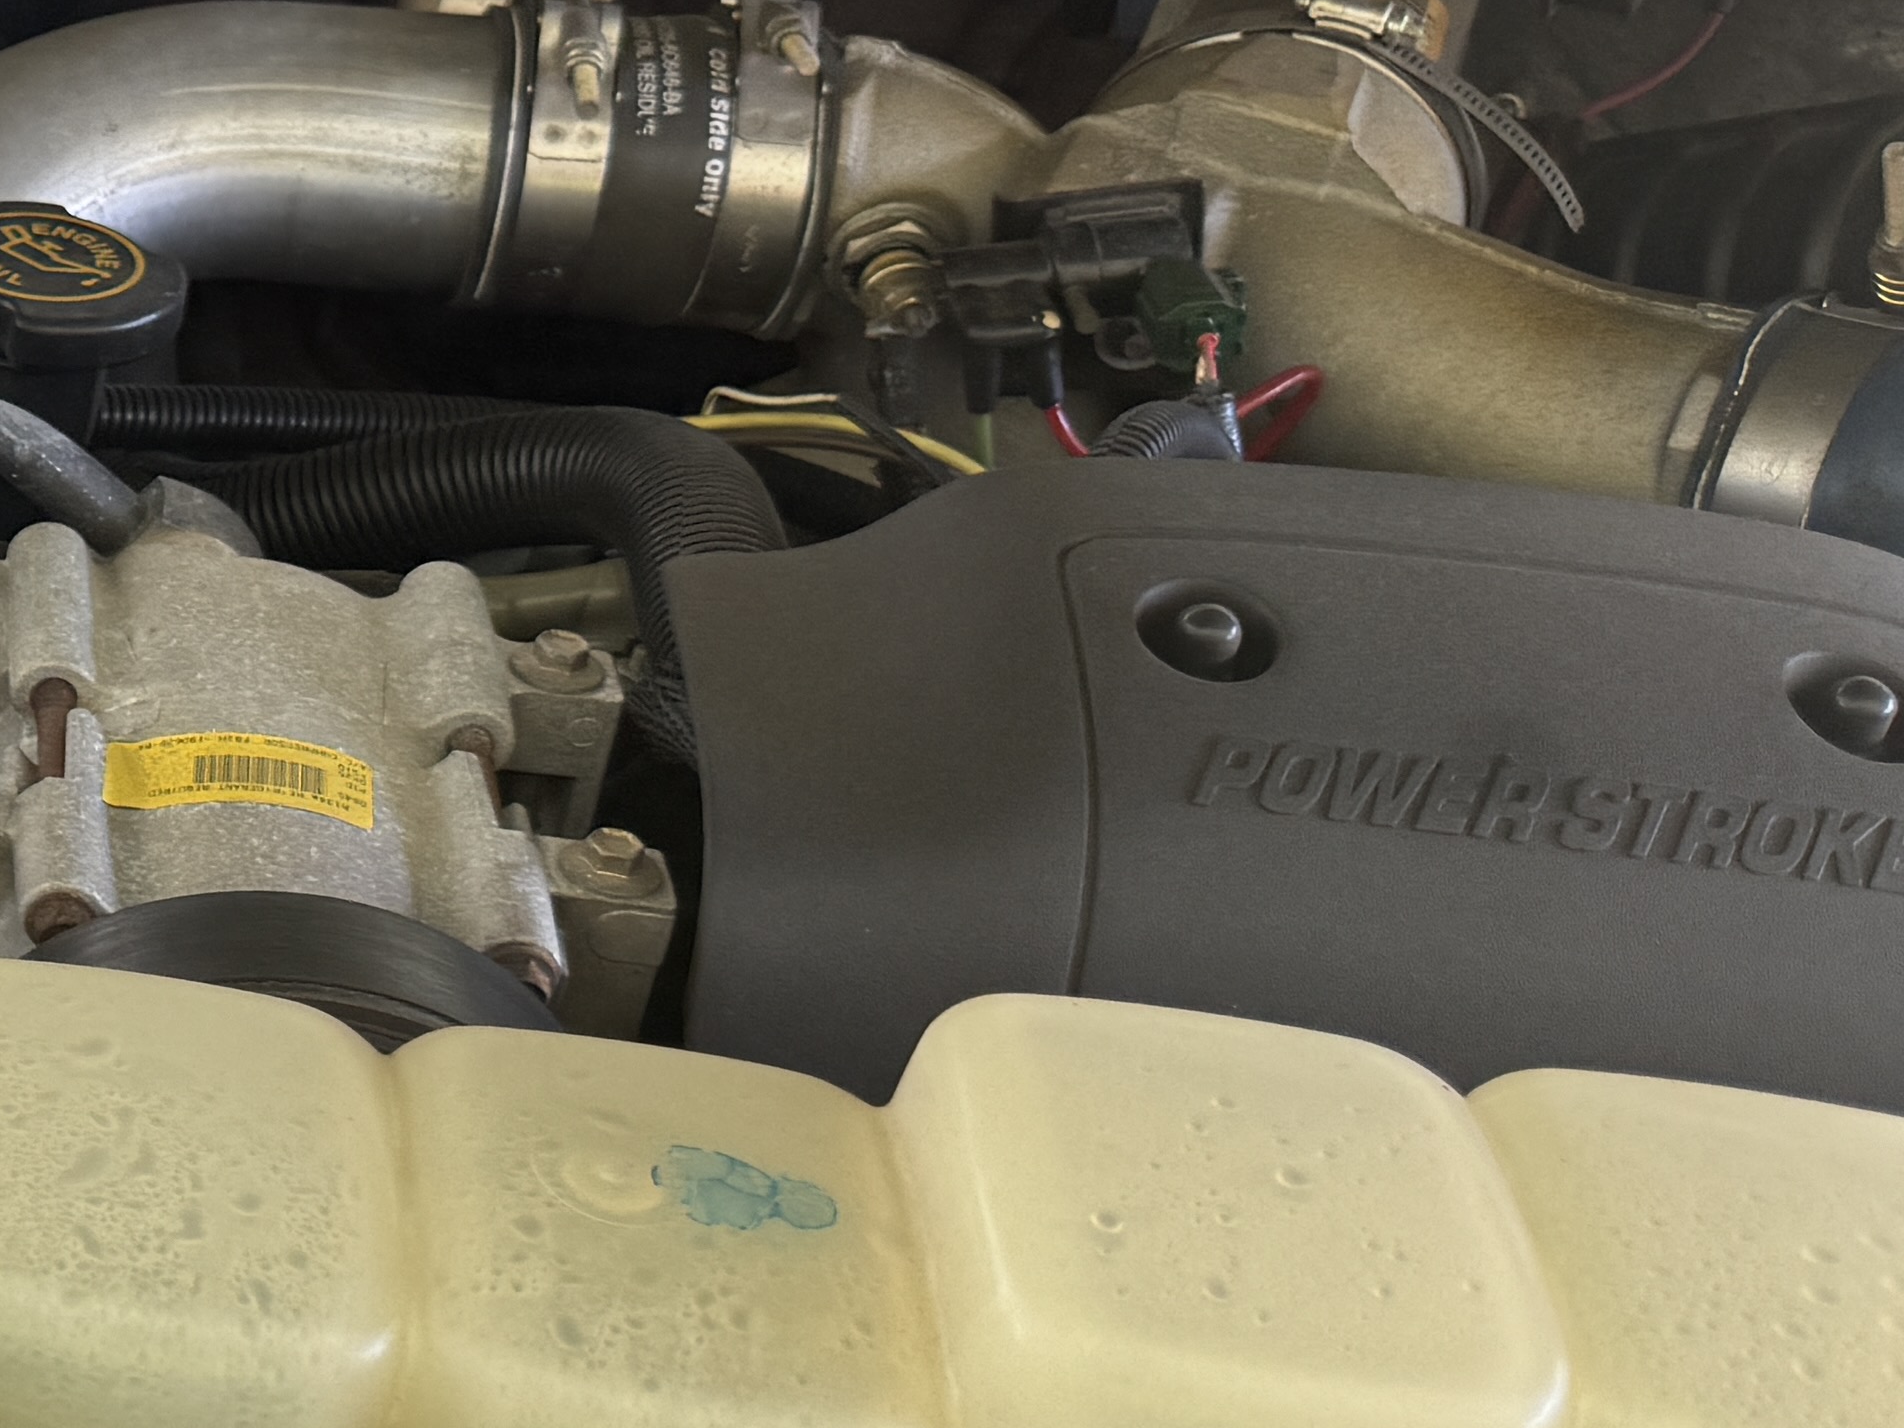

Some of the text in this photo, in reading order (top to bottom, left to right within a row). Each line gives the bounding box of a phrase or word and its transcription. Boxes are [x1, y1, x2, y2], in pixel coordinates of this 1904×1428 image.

[706, 97, 731, 152] side
[694, 157, 724, 218] only
[30, 223, 122, 270] ENGINE
[1192, 733, 1904, 892] POWERSTROK
